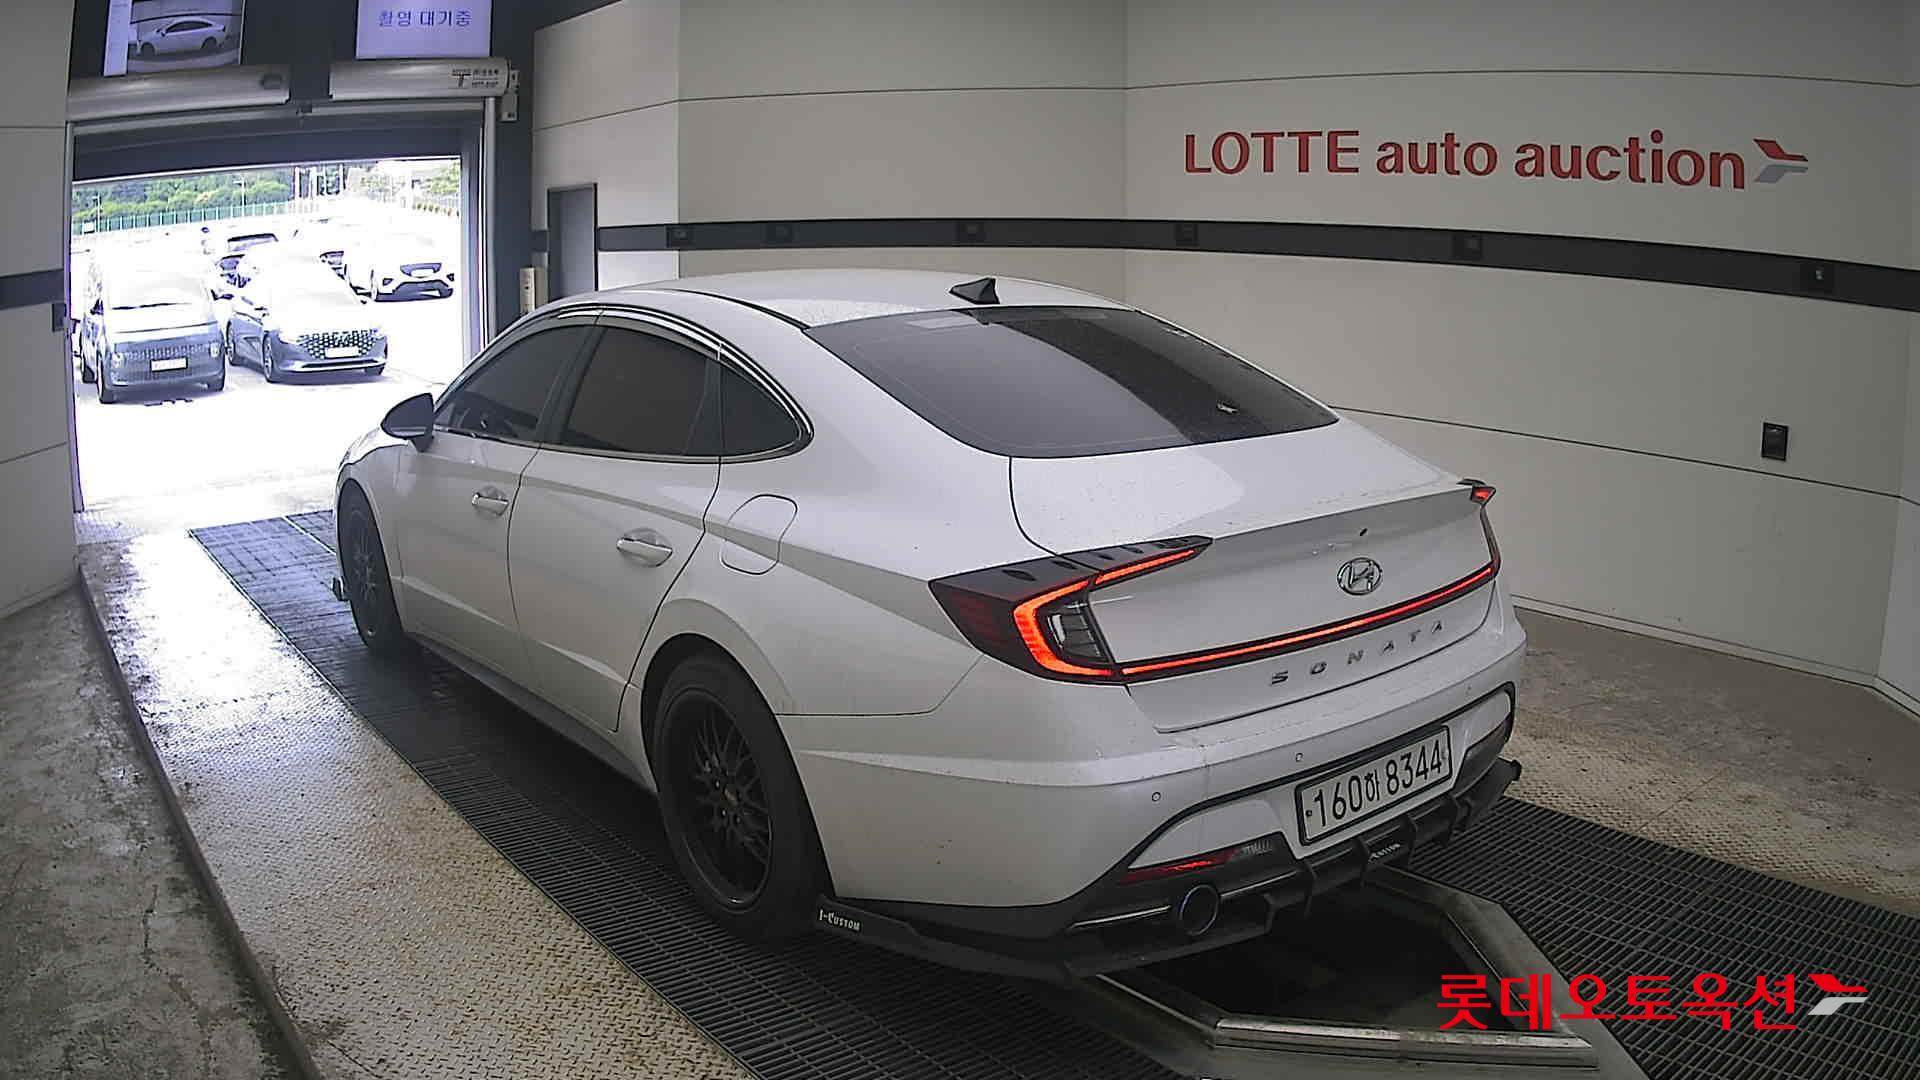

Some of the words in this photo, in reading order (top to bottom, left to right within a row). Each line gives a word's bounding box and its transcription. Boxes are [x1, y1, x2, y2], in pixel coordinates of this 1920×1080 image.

[420, 10, 472, 27] 대기중
[1185, 130, 1359, 174] LOTTE
[1376, 132, 1498, 177] auto
[1514, 130, 1745, 190] auction
[1270, 620, 1443, 686] SONATA
[1314, 769, 1380, 827] 160하
[1386, 739, 1442, 795] 8344
